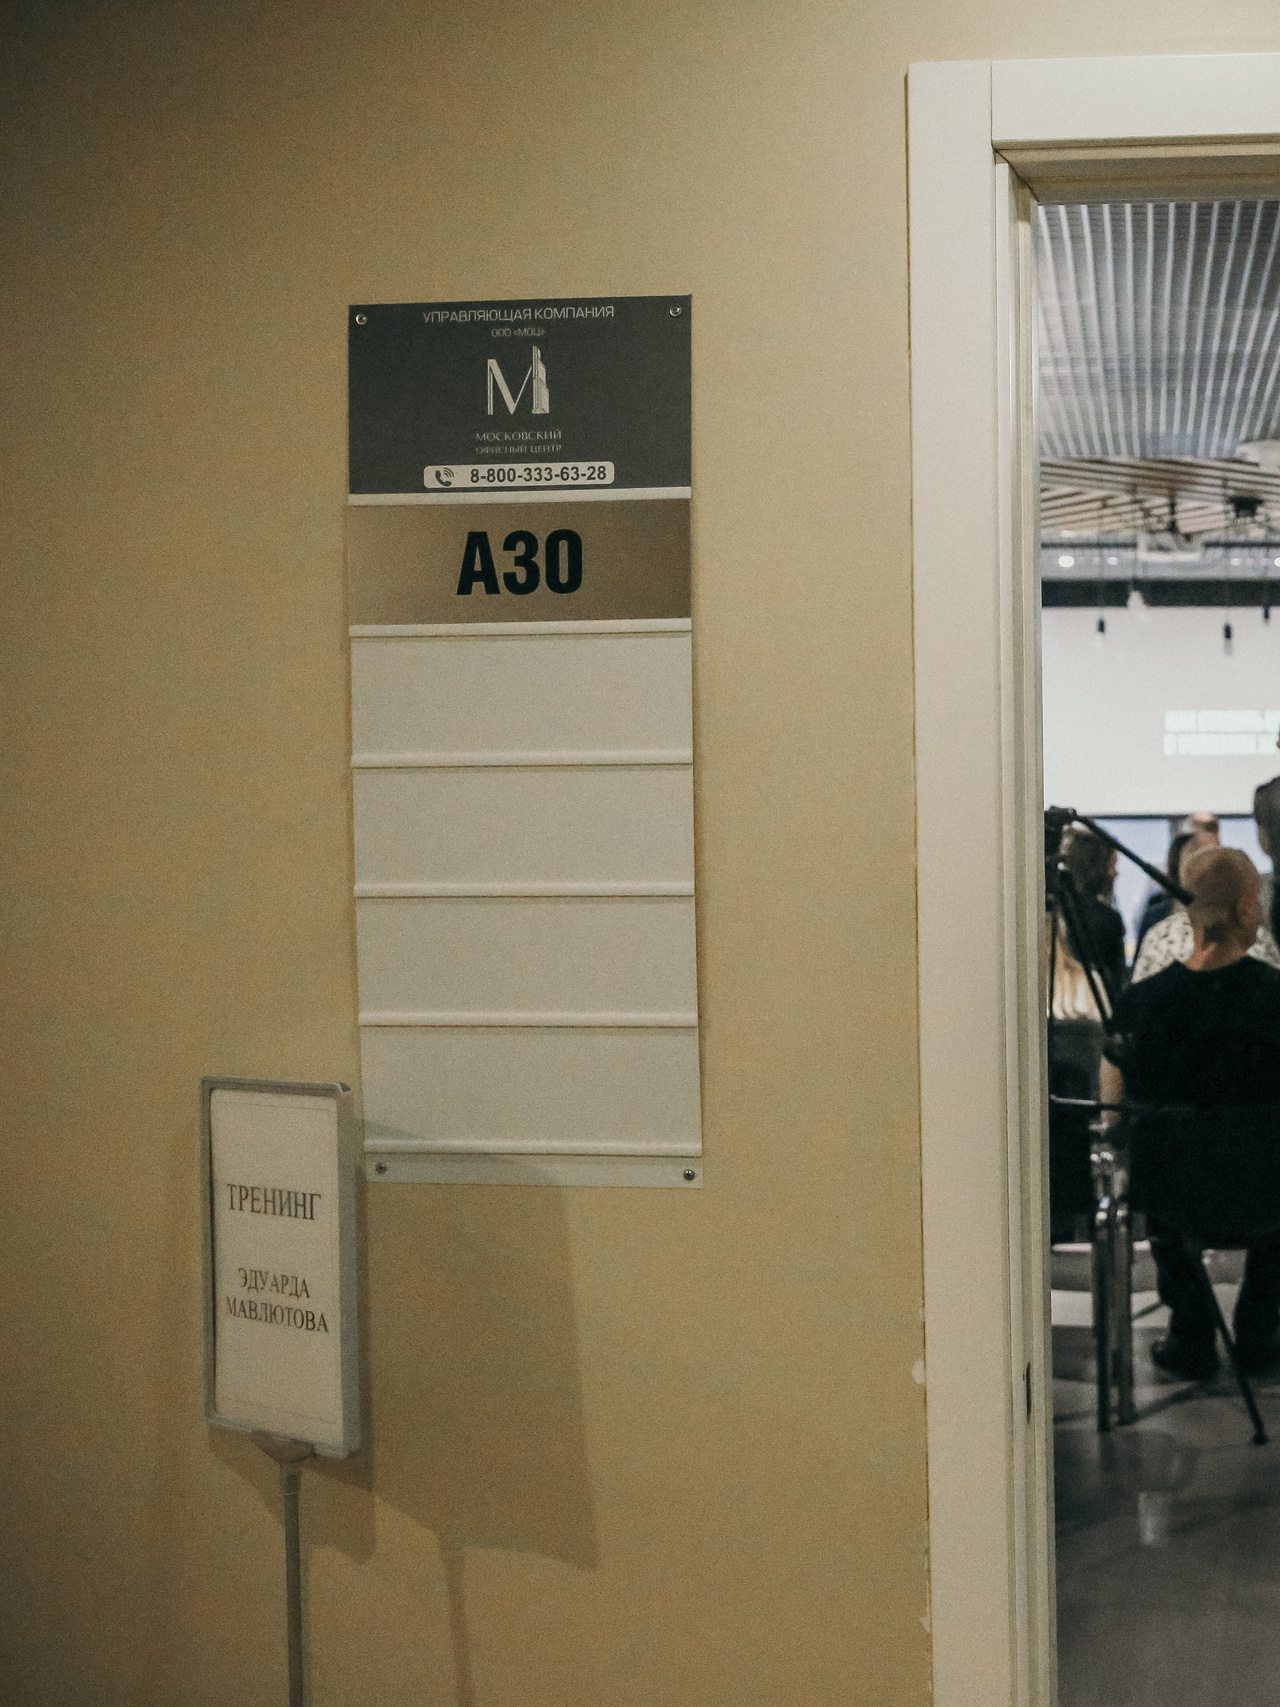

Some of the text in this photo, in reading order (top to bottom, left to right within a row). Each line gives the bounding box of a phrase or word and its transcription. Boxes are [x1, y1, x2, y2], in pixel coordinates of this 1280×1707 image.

[423, 306, 615, 323] УПРАВЛЯЮЩАЯ КОМПАНИЯ
[476, 428, 562, 442] МОСКОВСКИЙ
[530, 444, 562, 454] ЦЕНТР
[470, 465, 607, 484] 8-800-333-63-28
[227, 1183, 322, 1221] ТРЕНИНГ
[237, 1266, 311, 1299] ЭДУАРДА
[226, 1296, 330, 1334] МАВЛЮТОВА
